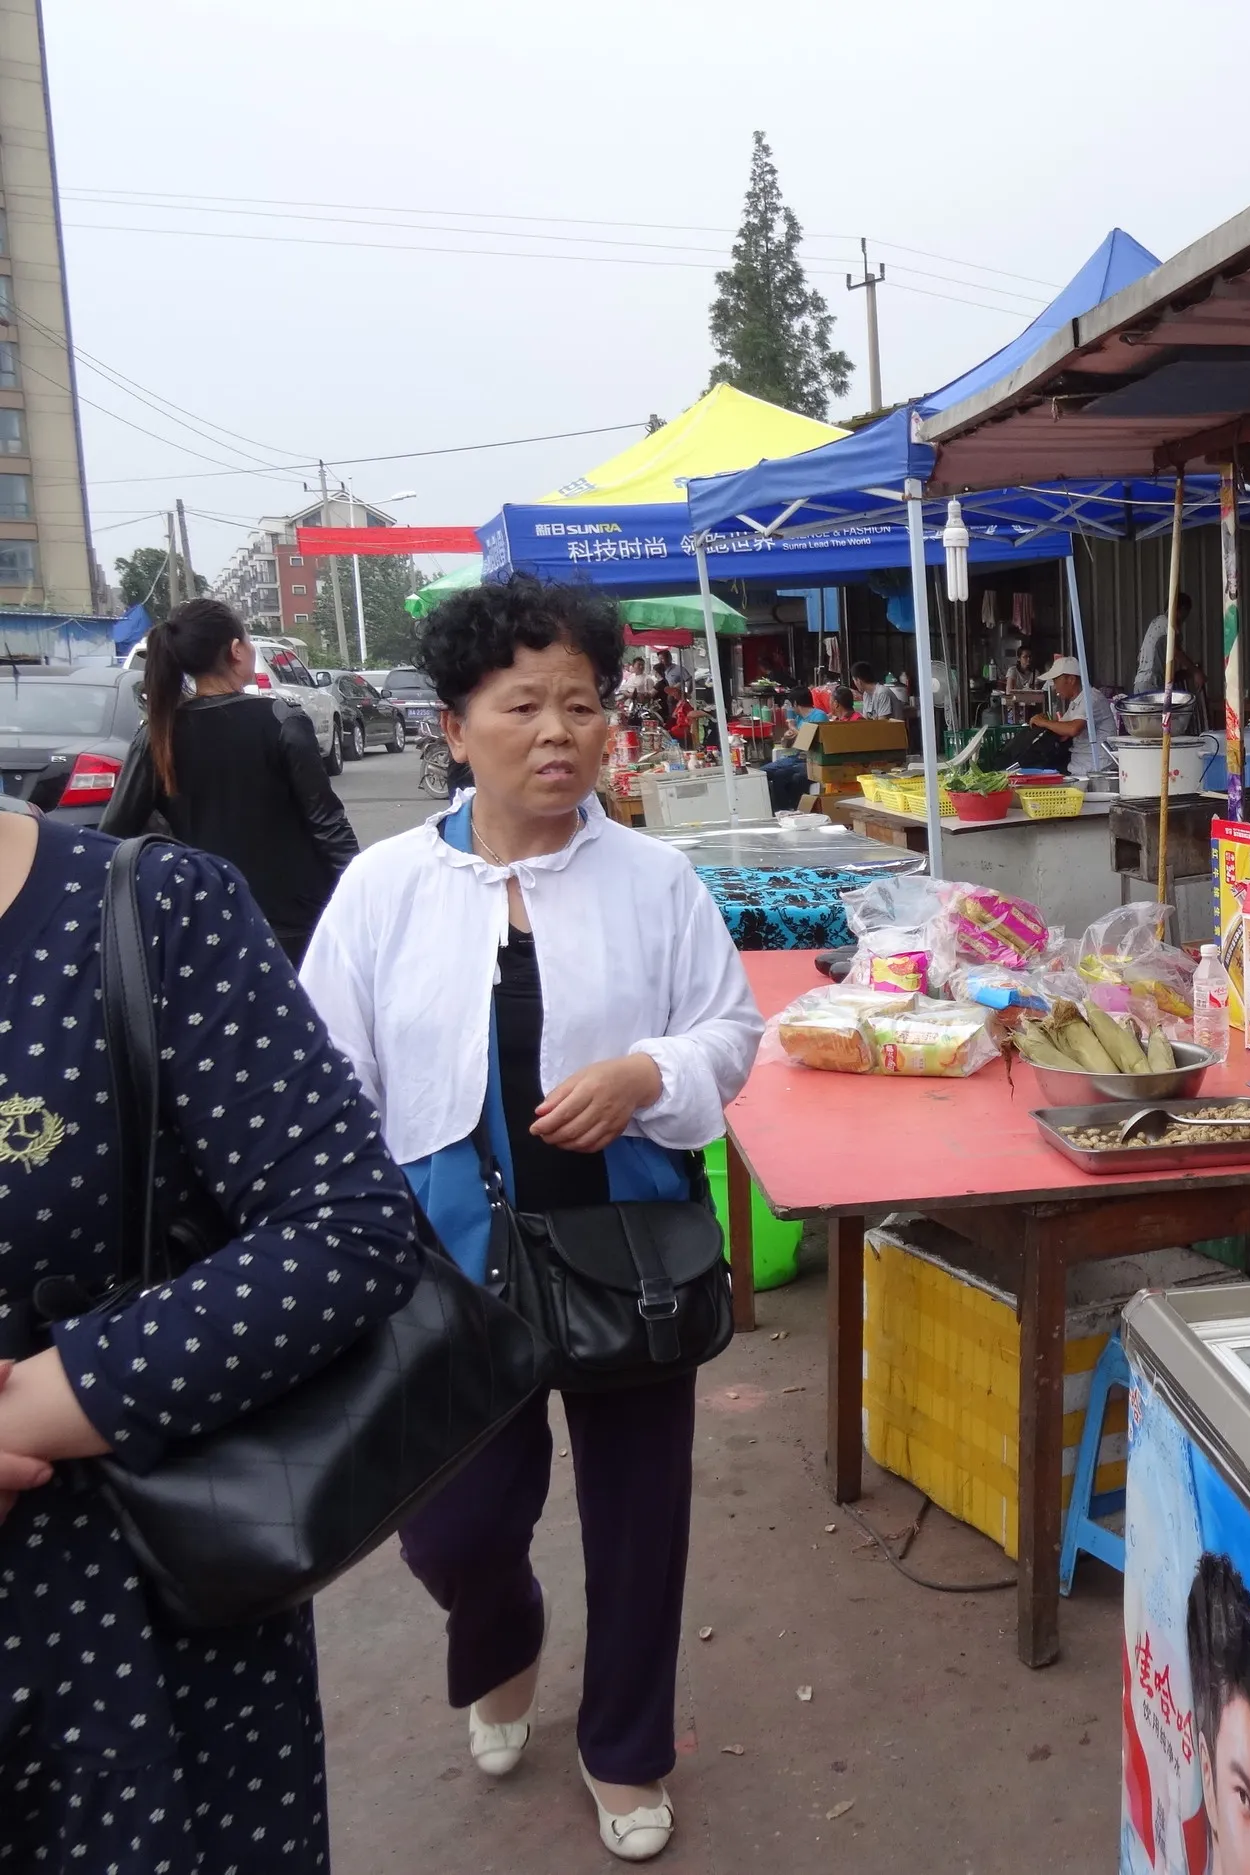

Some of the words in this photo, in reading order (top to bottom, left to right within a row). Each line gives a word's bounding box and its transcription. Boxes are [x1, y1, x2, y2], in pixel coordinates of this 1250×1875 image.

[567, 522, 622, 535] SUNRA
[567, 536, 667, 564] 科技时尚
[782, 542, 807, 551] Sunra
[808, 540, 830, 550] Lead
[831, 538, 847, 548] The
[847, 536, 871, 547] World
[1134, 1630, 1197, 1765] 娃哈哈
